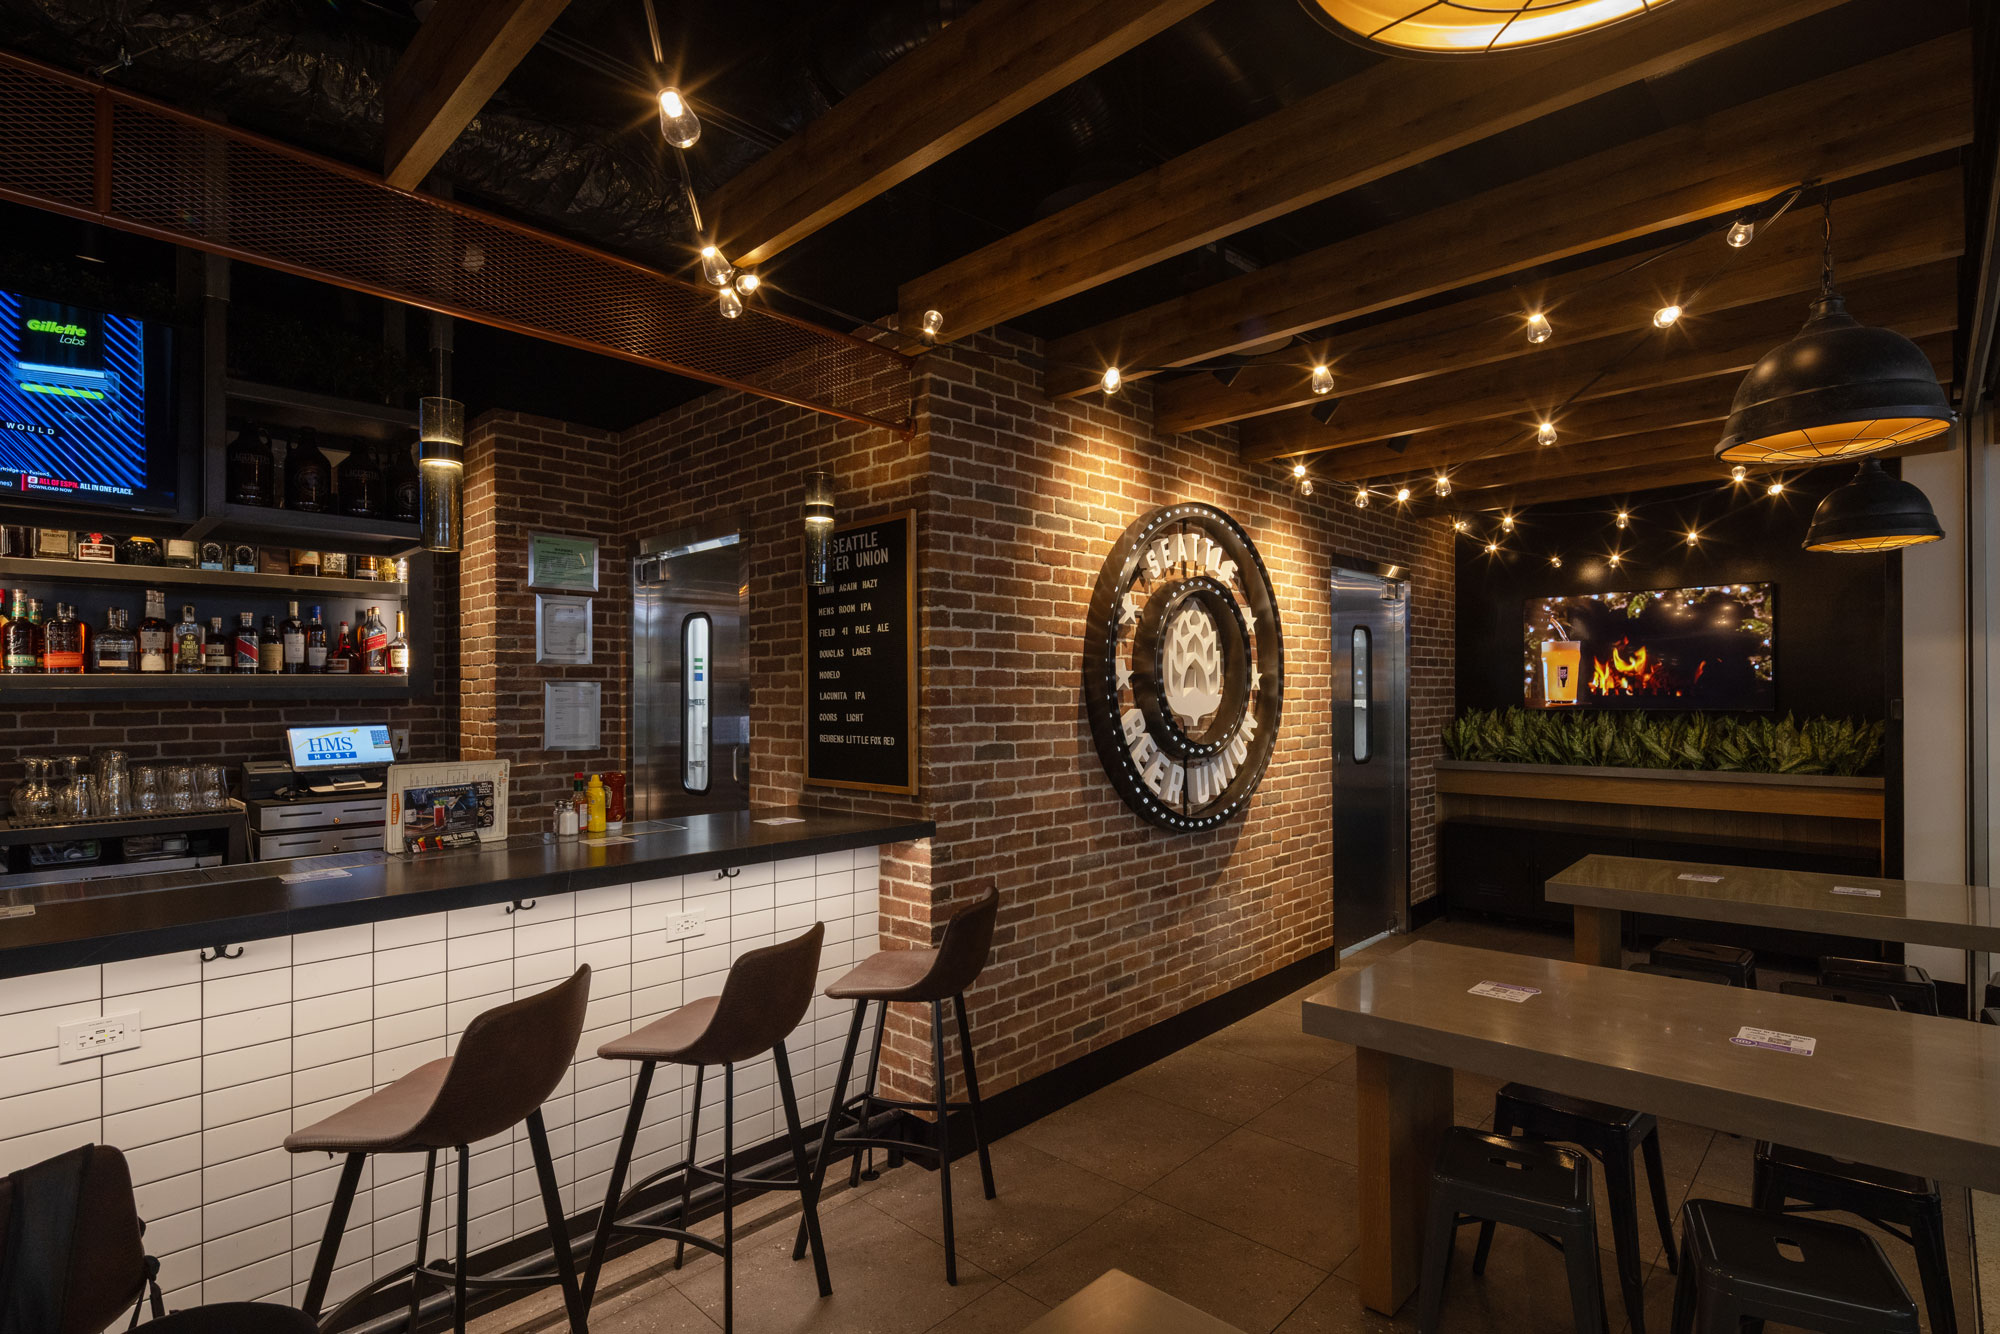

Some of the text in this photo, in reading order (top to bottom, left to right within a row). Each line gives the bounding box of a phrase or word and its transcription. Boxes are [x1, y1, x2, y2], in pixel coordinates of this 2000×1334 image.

[27, 319, 87, 337] Gillette
[60, 334, 86, 346] Labs
[6, 422, 55, 435] WOULD
[28, 484, 59, 492] DOWNLOAD
[60, 481, 79, 489] ESPN.
[112, 488, 134, 496] PLACE.
[833, 531, 878, 554] SEATTLE
[855, 547, 889, 568] UNION
[1140, 533, 1239, 589] SEATTLE
[818, 579, 878, 595] DAWN AGAIN HAZY
[818, 602, 872, 616] MENS ROOM IPA
[819, 622, 890, 638] FIELD 41 PALE ALE
[819, 646, 872, 659] DOUGLAS LAGER
[819, 670, 841, 680] MODELO
[819, 691, 866, 701] LAGUNITA IPA
[819, 713, 864, 723] COORS LIGHT
[308, 736, 354, 753] HMS
[819, 734, 896, 747] REUBENS LITTLE FOX RED
[314, 752, 351, 760] HOST
[1120, 708, 1259, 805] BEER UNION
